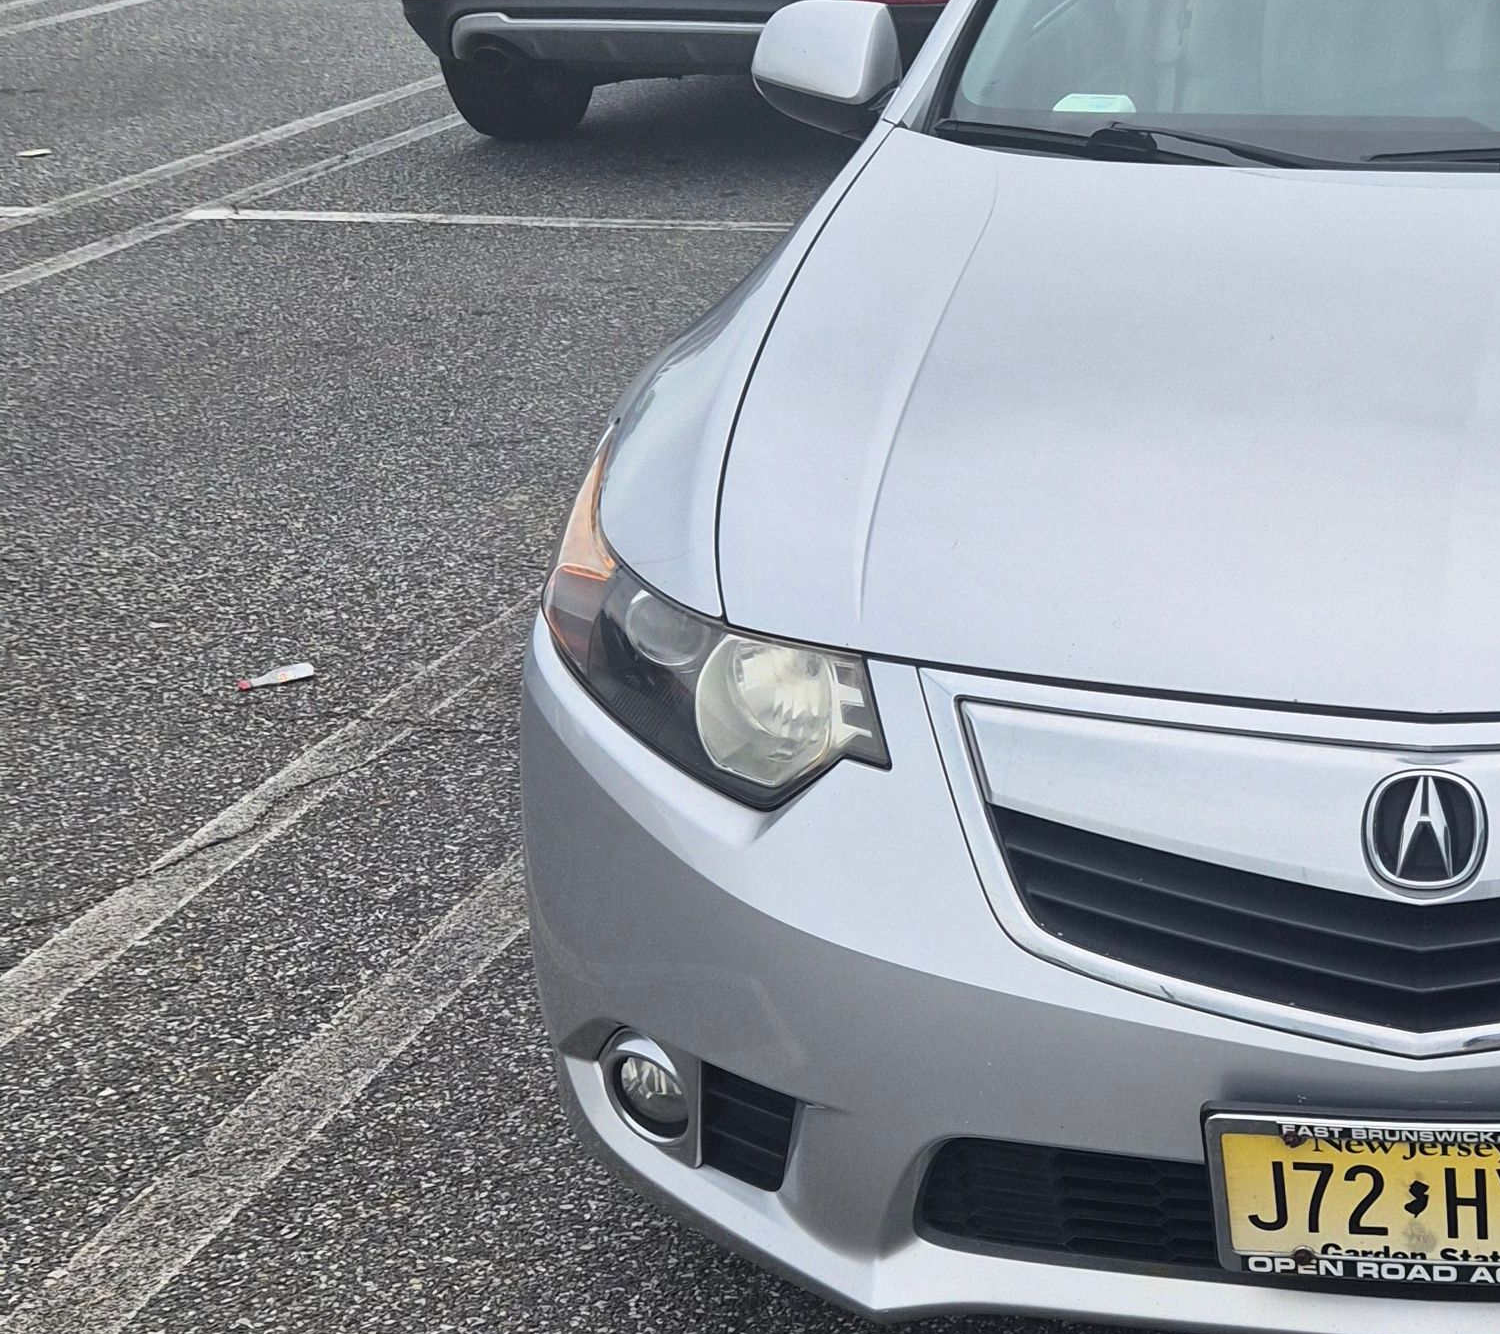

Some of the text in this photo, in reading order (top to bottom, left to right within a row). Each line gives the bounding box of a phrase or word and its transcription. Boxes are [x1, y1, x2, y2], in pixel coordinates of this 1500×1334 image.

[1312, 1138, 1397, 1155] New
[1247, 1161, 1389, 1237] J72
[1320, 1243, 1428, 1261] Garden
[1248, 1256, 1344, 1277] OPEN
[1357, 1262, 1457, 1283] ROAD
